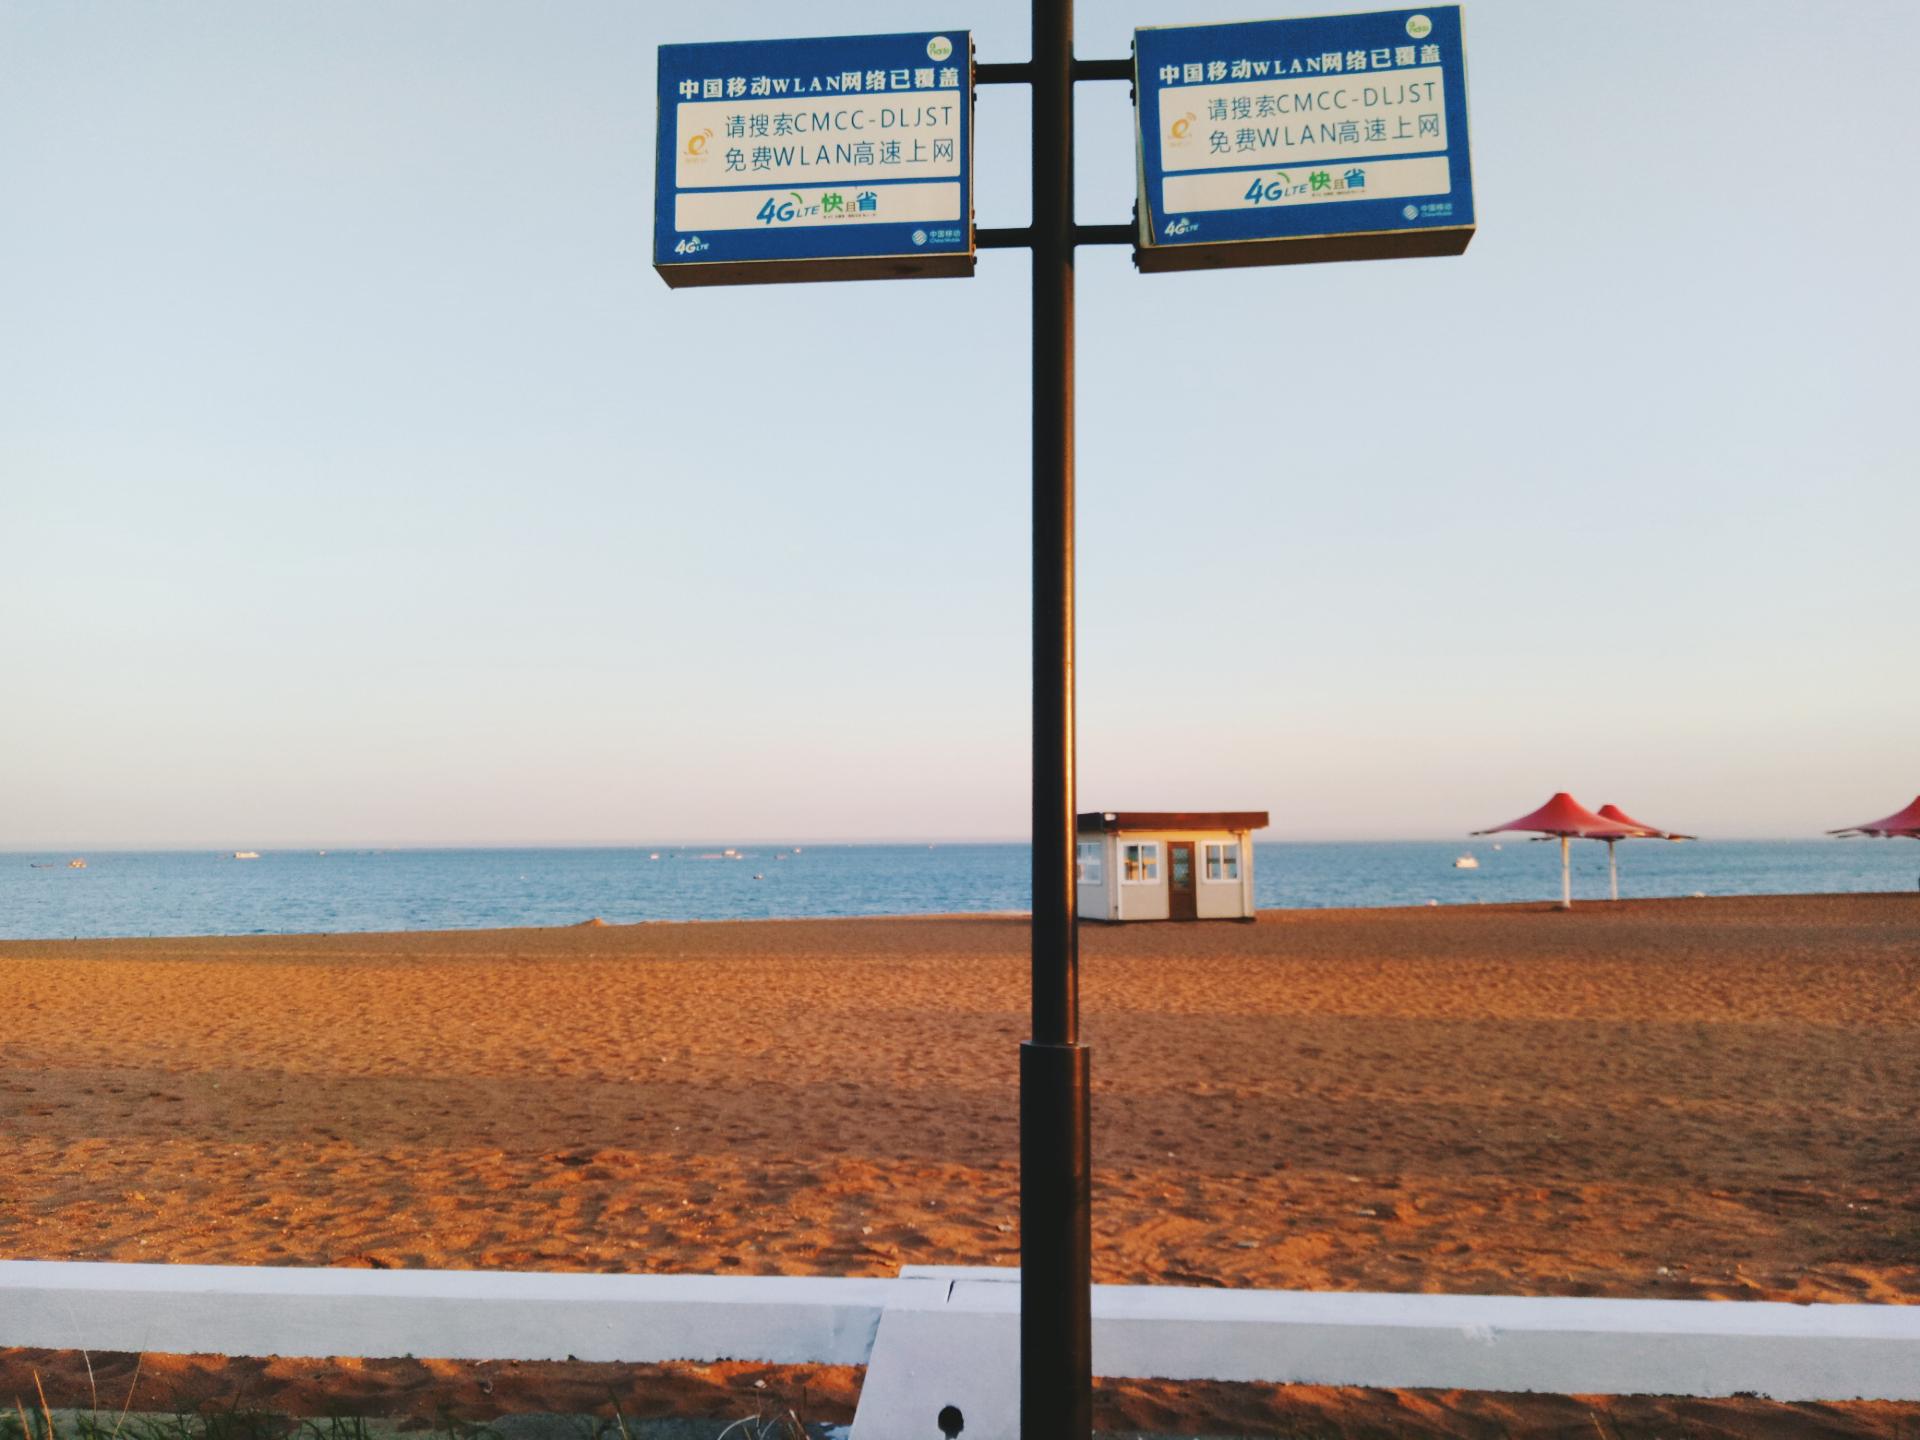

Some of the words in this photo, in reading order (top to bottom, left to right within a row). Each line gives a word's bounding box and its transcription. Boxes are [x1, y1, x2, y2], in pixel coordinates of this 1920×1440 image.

[678, 67, 960, 99] 中国移动WLAN网络已覆盖
[1159, 44, 1441, 85] 中国移动WLAN网络已覆盖
[1207, 82, 1436, 121] 请搜索CMCC-DLJST
[725, 106, 953, 138] 请搜索CMCC-DLJST
[1208, 113, 1440, 155] 免费WLAN高速上网
[724, 138, 954, 173] 免费WLAN高速上网
